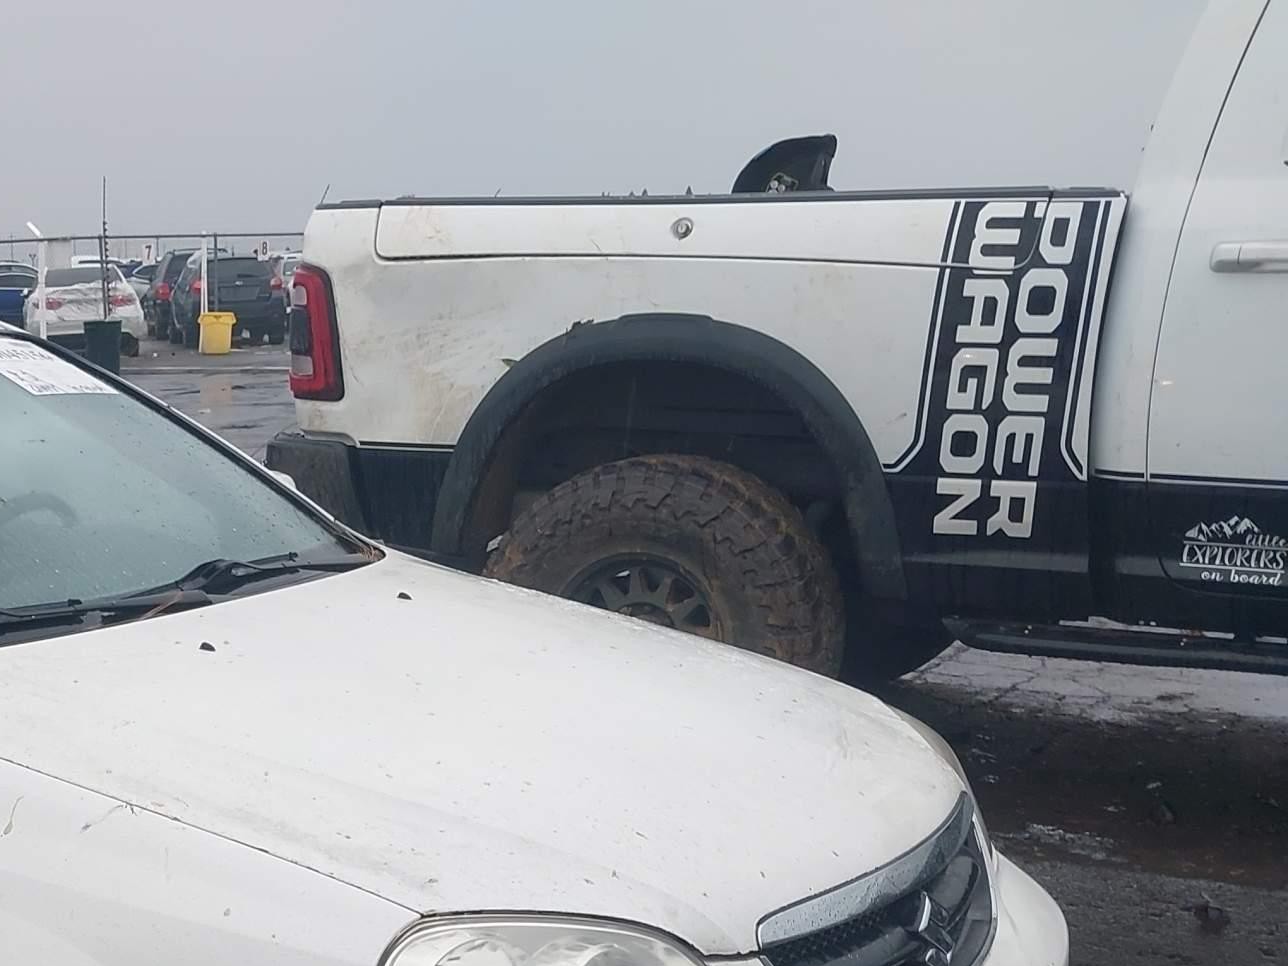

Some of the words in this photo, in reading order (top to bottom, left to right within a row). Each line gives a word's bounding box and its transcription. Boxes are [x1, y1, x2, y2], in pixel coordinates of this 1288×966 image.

[145, 244, 152, 260] 7
[262, 241, 268, 256] 8
[933, 202, 1027, 536] WAGON
[986, 202, 1084, 538] POWER
[1182, 543, 1287, 570] EXPLORERS
[1201, 571, 1223, 582] on
[1230, 568, 1282, 586] board
